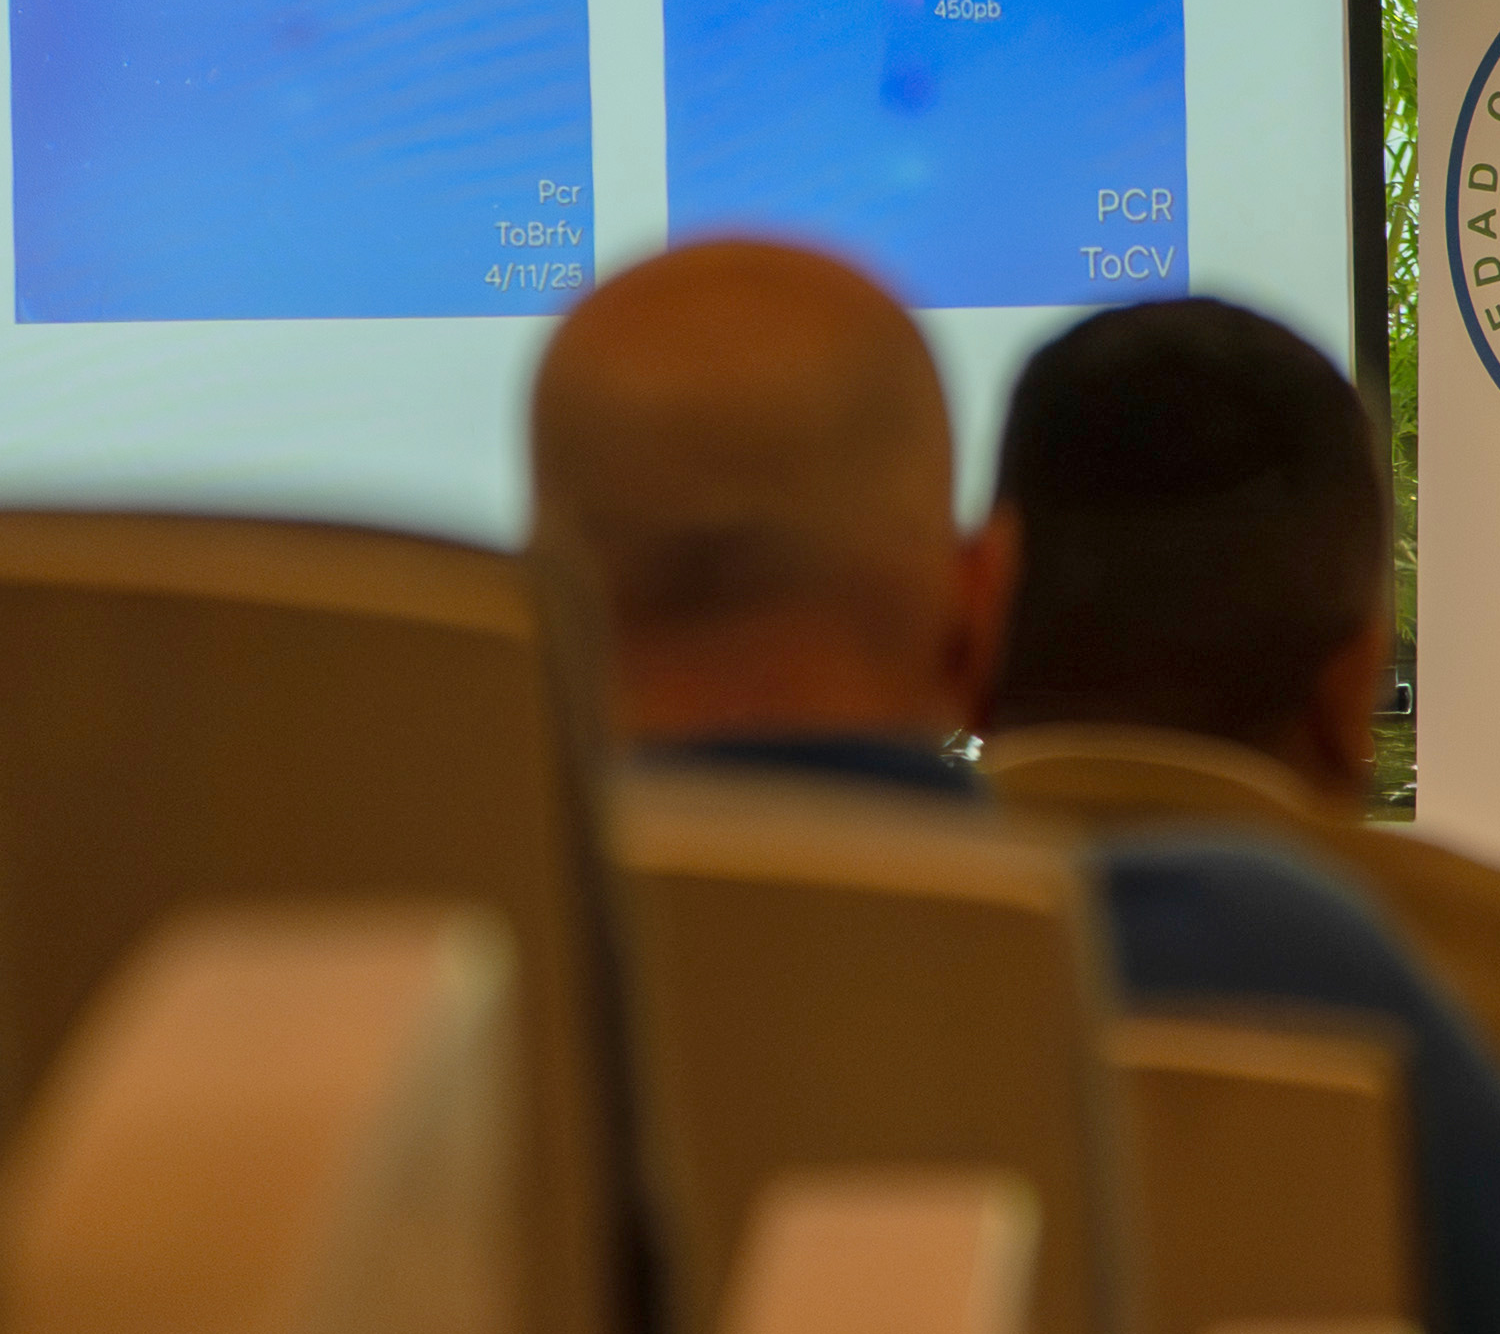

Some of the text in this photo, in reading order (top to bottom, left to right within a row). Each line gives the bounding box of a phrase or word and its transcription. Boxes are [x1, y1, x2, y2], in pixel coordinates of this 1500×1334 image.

[538, 179, 581, 205] Pcr
[1098, 189, 1174, 221] PCR
[494, 220, 582, 247] ToBrfv
[485, 263, 583, 291] 4/11/25
[1080, 246, 1175, 280] ToCV
